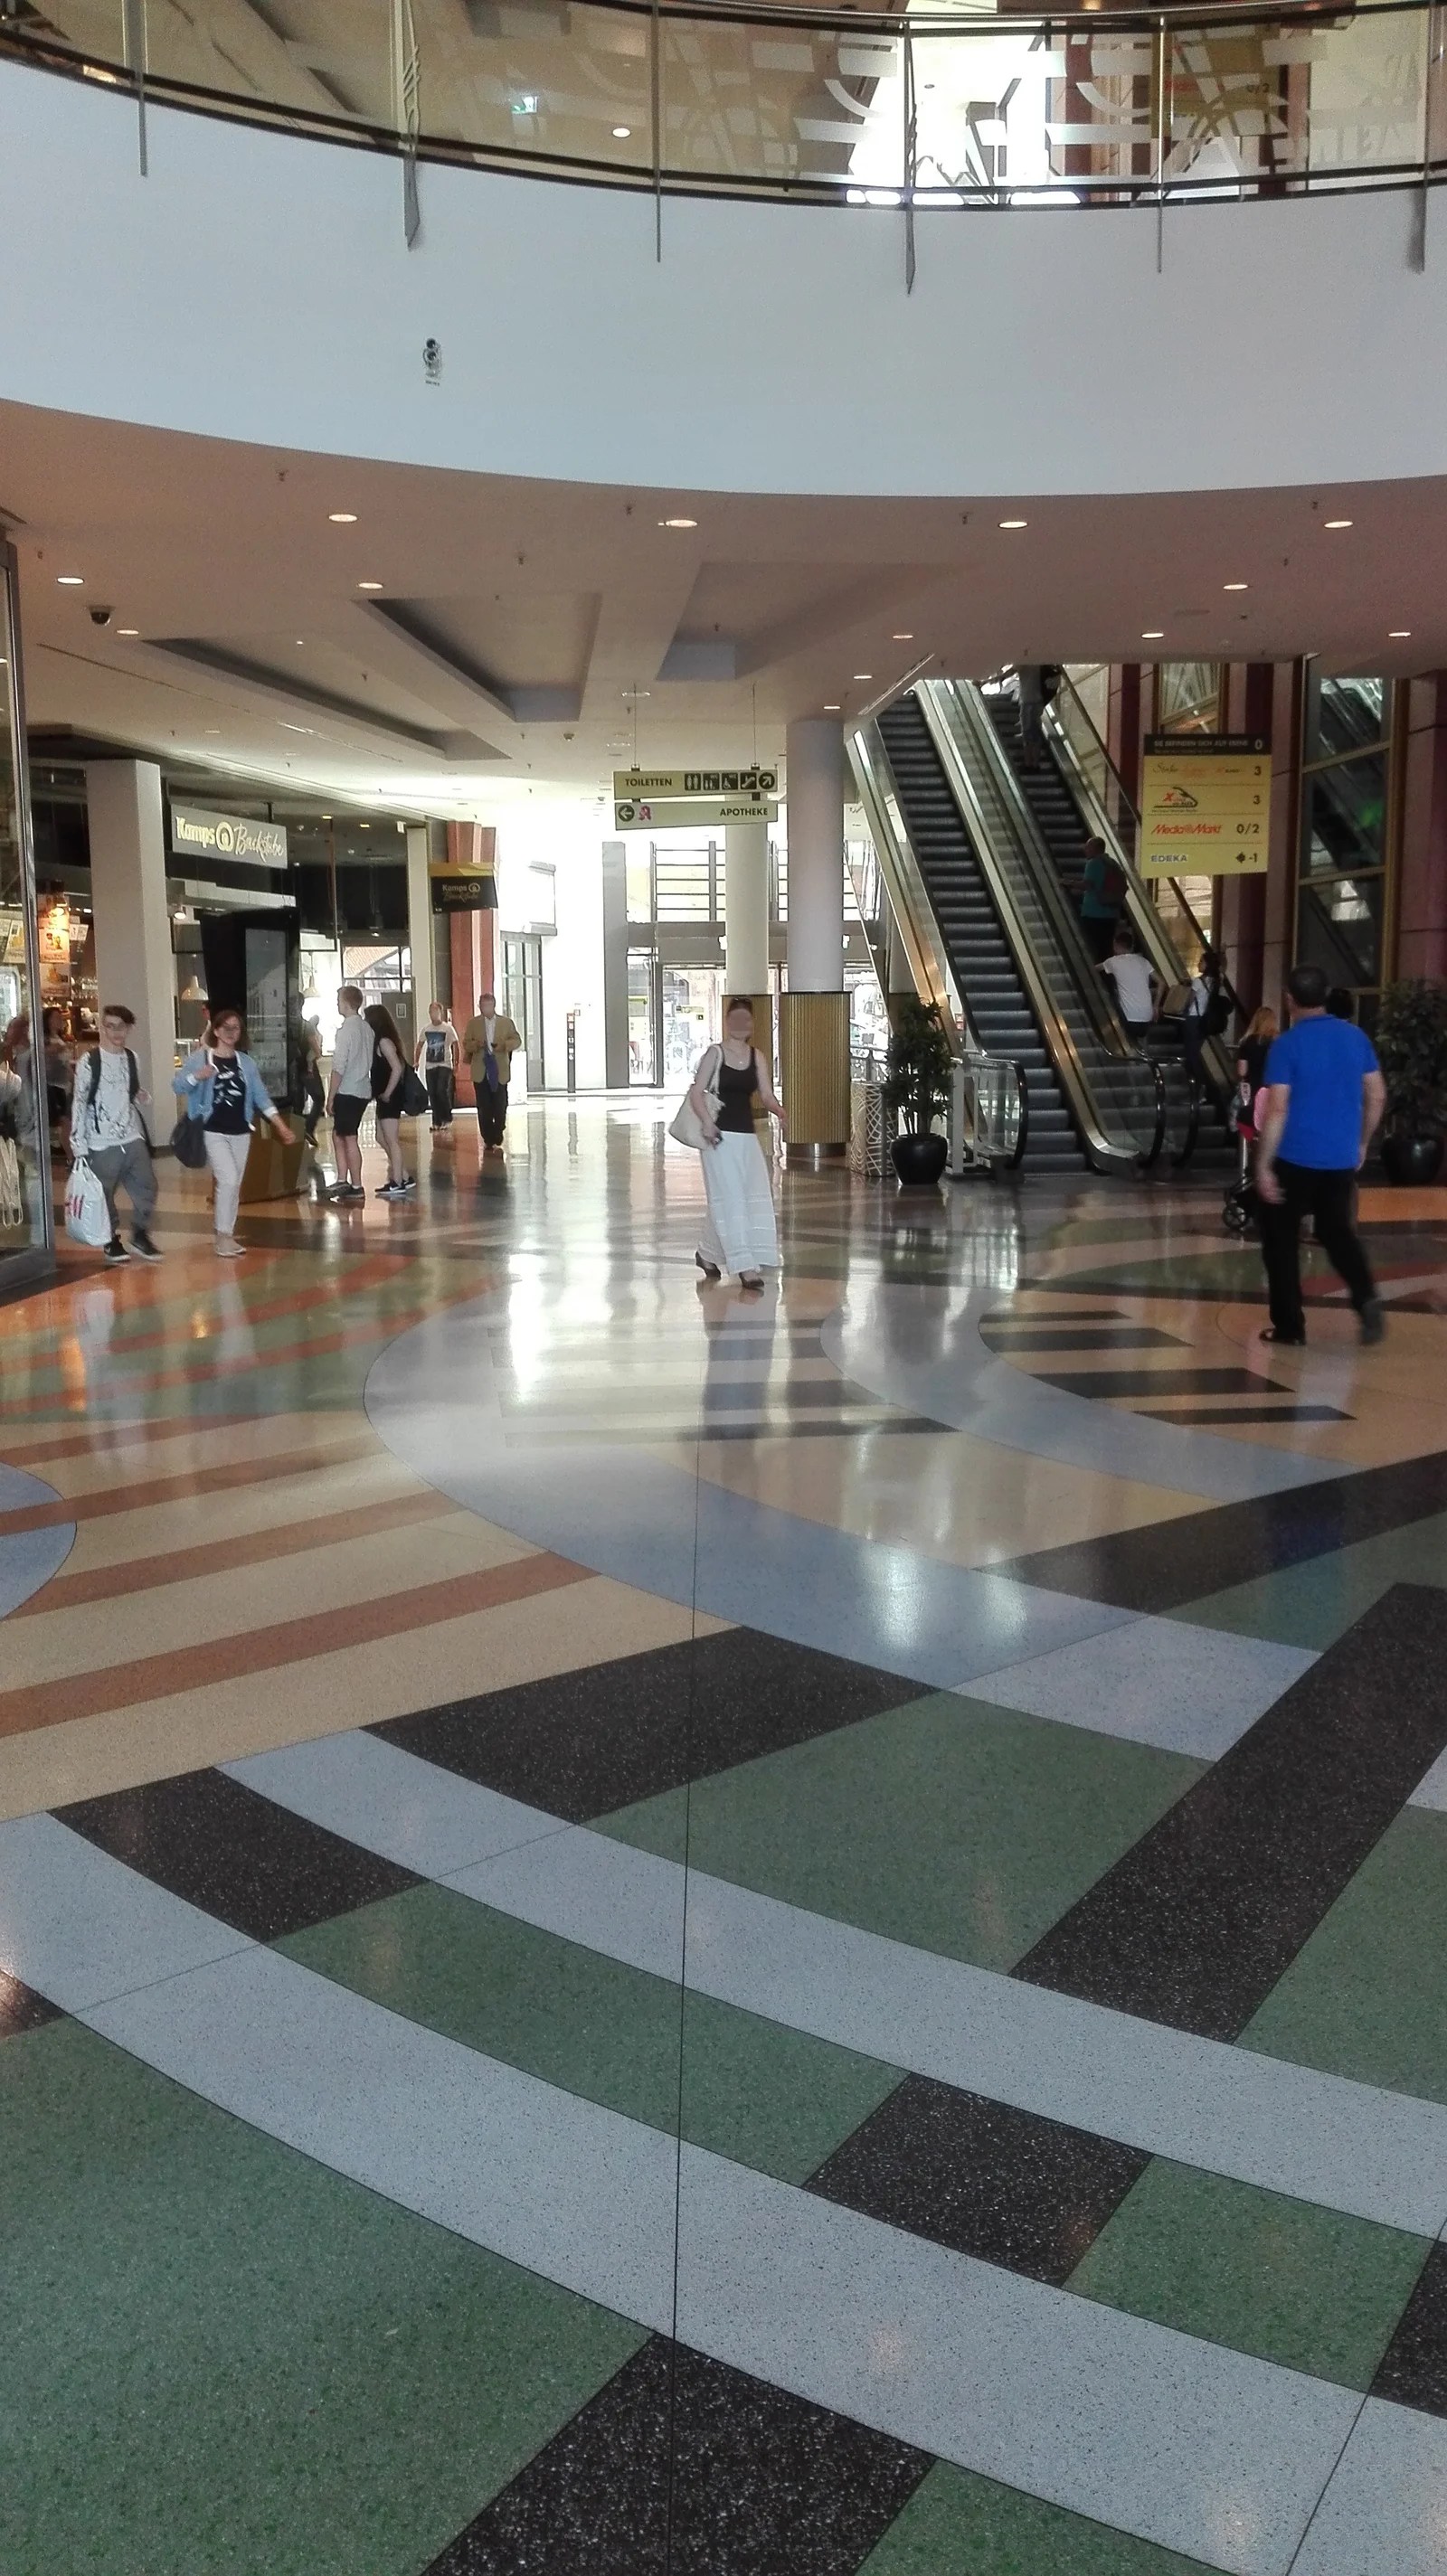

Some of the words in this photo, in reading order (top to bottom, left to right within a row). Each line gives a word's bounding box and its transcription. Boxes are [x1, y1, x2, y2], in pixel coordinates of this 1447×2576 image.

[1254, 739, 1263, 750] 0
[1254, 766, 1262, 776] 3
[625, 778, 672, 787] TOILETTEN
[1253, 795, 1261, 805] 3
[720, 807, 768, 816] APOTHEKE
[175, 816, 216, 848] Kamps
[1236, 824, 1259, 834] 0/2
[1151, 854, 1187, 863] EDEKA
